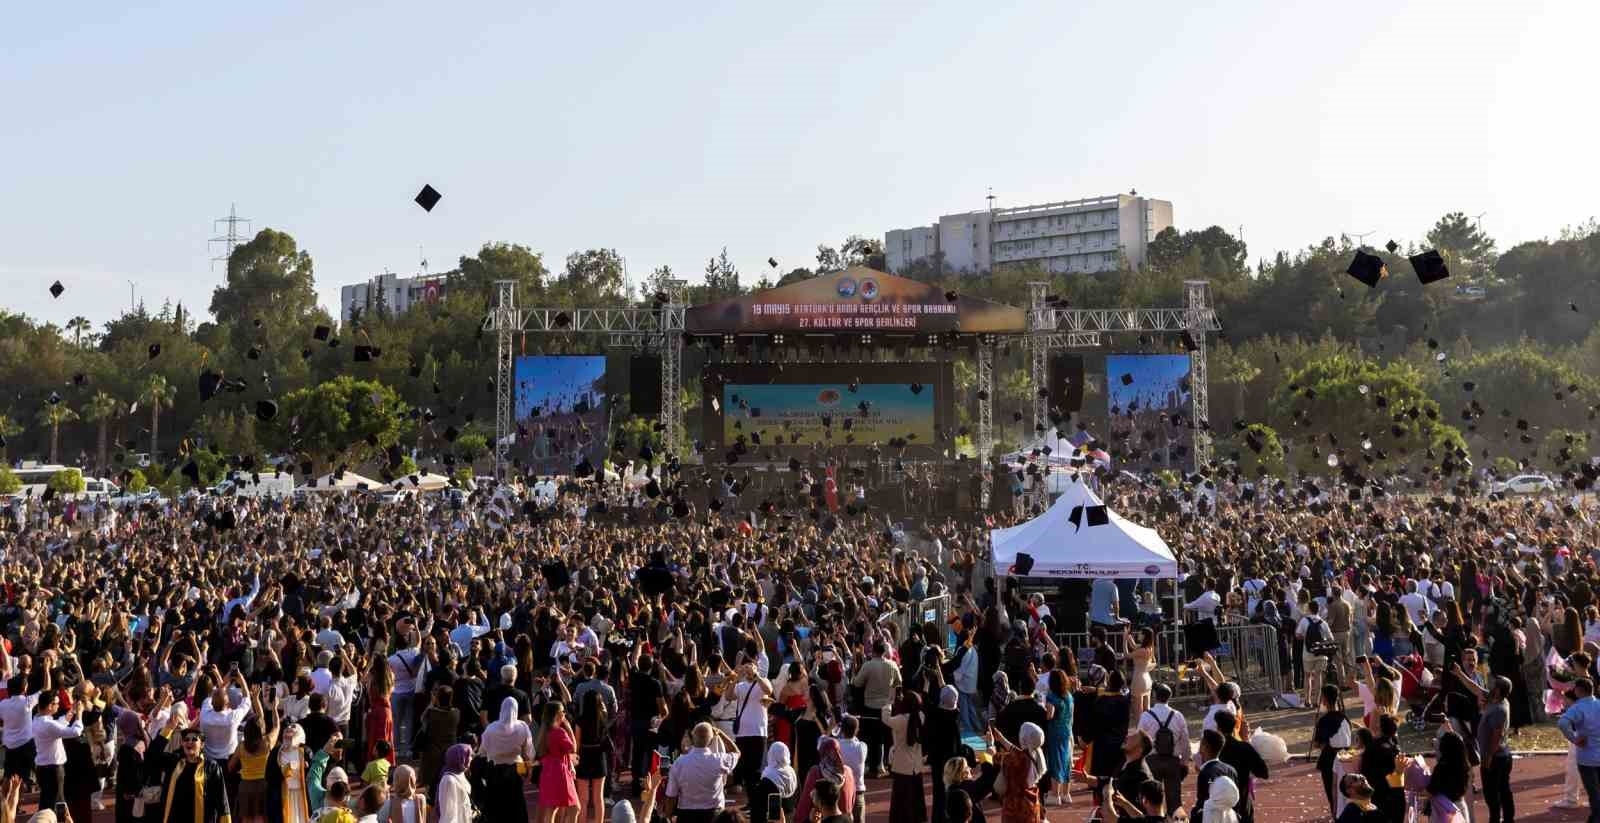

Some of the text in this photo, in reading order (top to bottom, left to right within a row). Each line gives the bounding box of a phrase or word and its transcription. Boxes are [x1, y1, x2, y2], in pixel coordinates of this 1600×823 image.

[752, 303, 762, 314] 19
[892, 303, 902, 314] VE
[903, 303, 922, 314] SPOR
[799, 317, 811, 329] 27.
[844, 317, 854, 328] VE
[855, 317, 874, 328] SPOR
